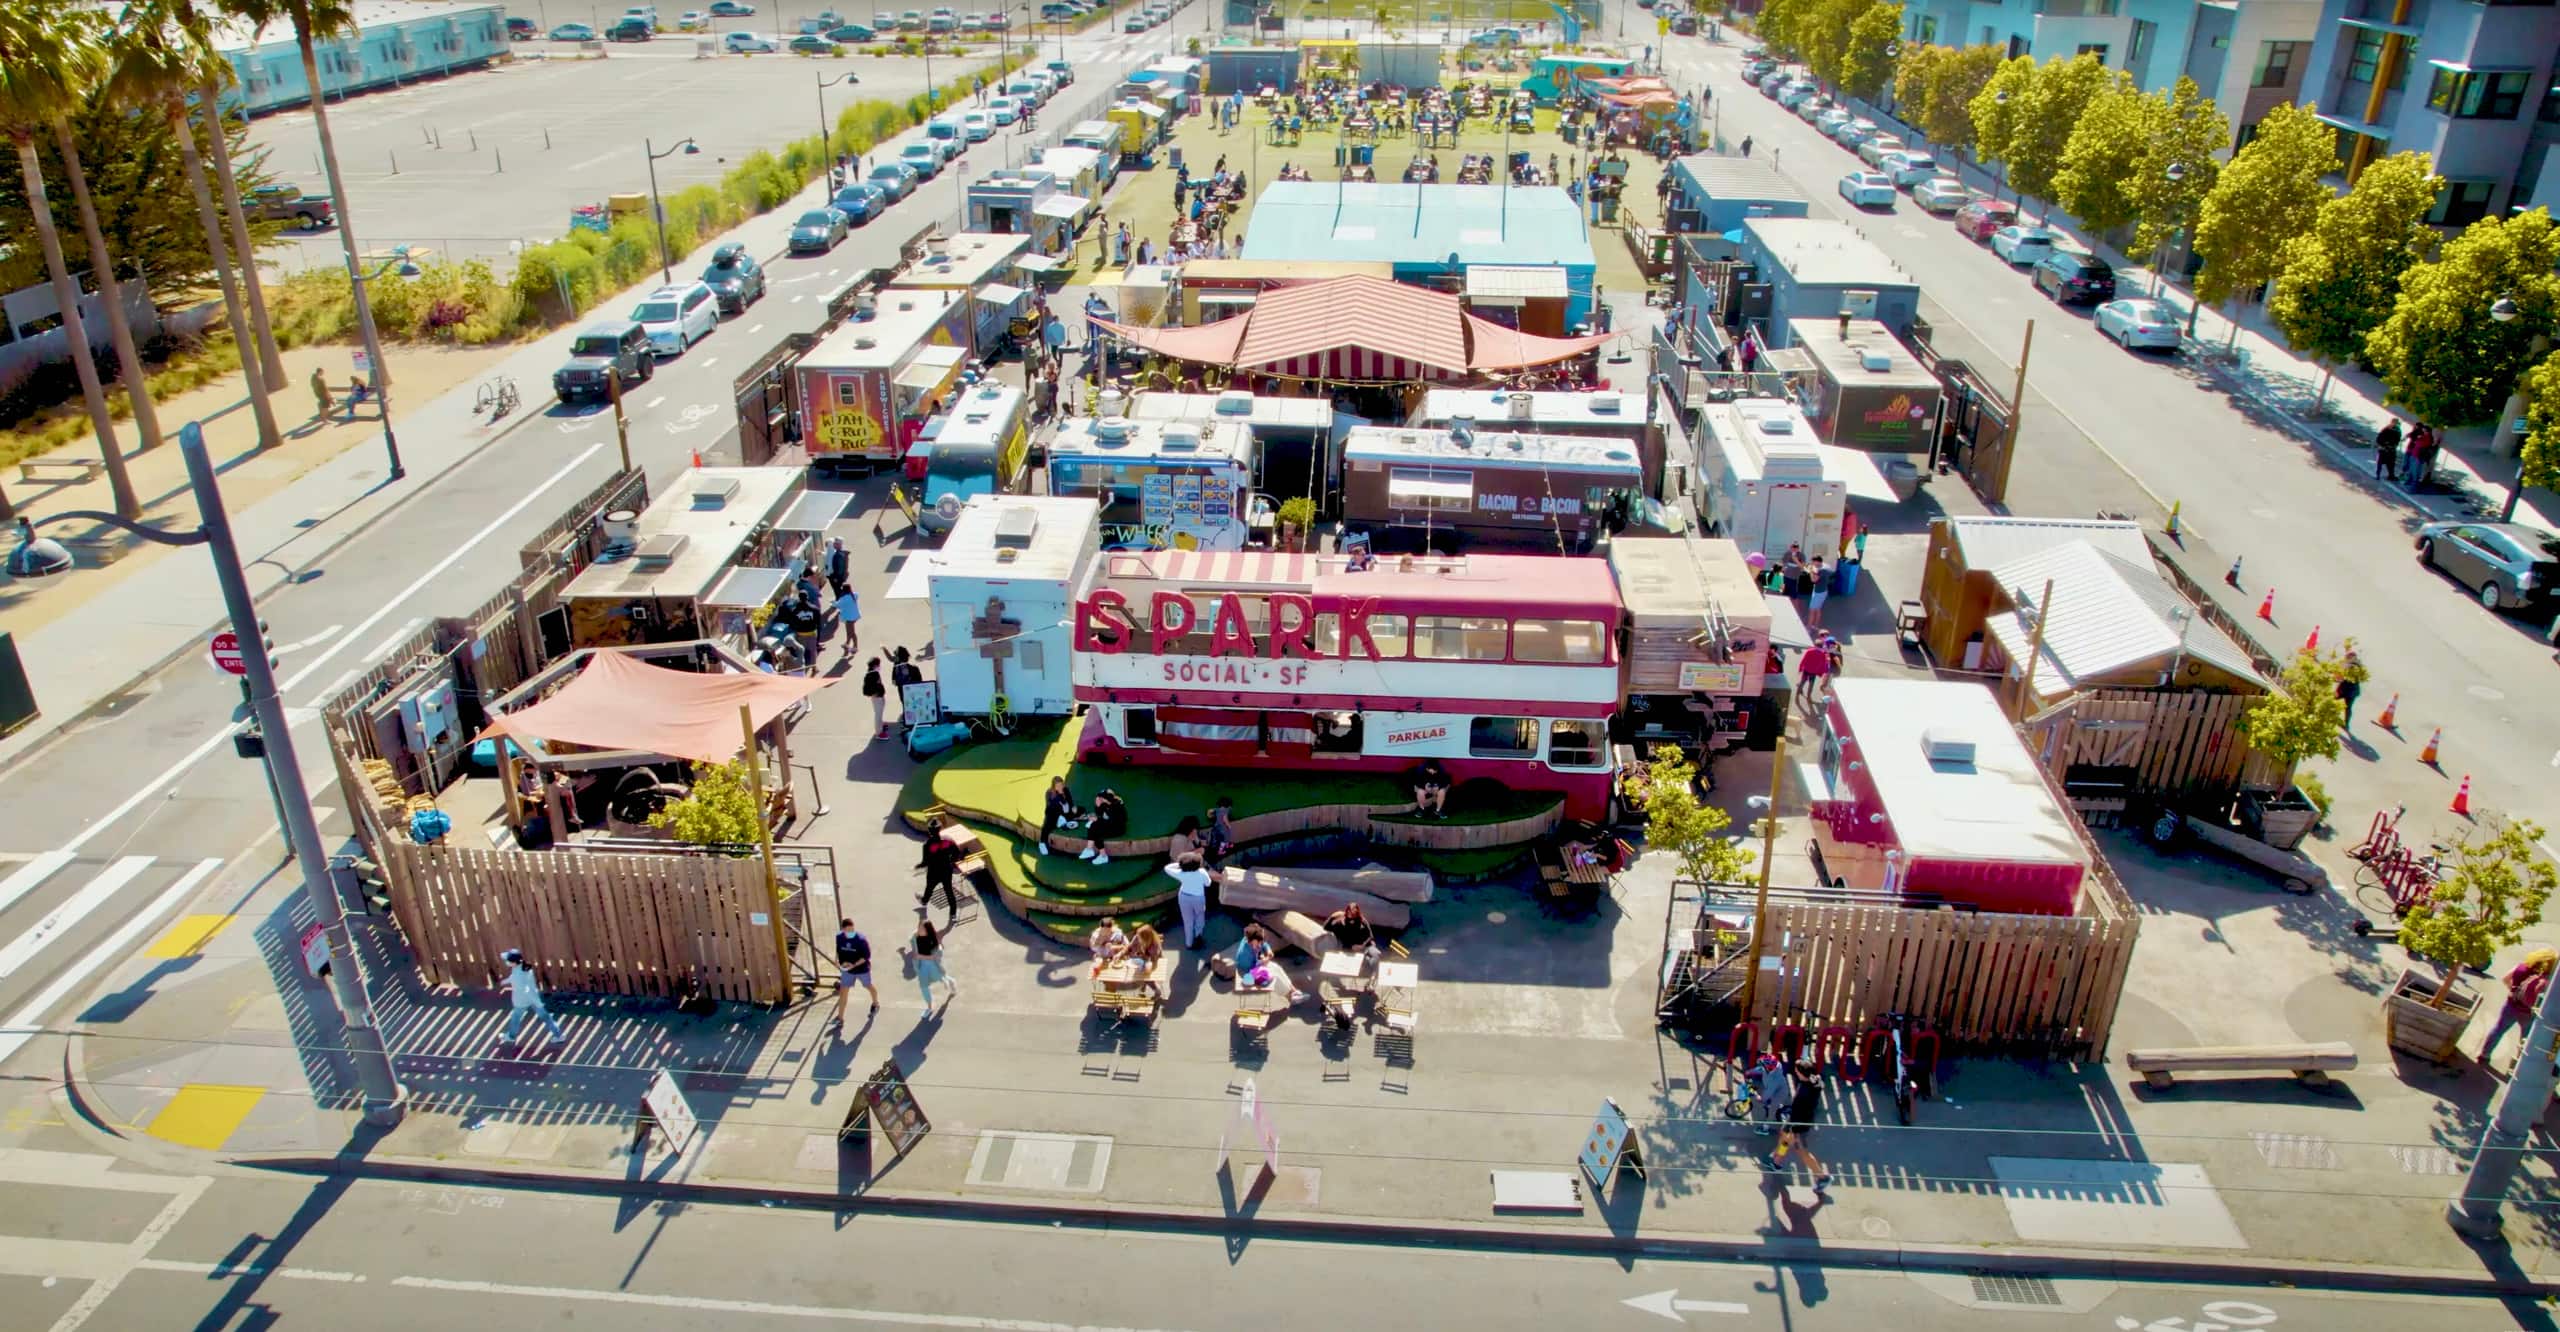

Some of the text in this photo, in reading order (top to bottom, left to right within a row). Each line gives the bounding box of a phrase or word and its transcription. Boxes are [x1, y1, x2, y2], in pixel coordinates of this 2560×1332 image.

[1478, 494, 1580, 514] BACON BACON
[1088, 588, 1382, 663] SPARK
[215, 641, 227, 649] DO
[224, 660, 246, 668] ENTE
[1163, 662, 1308, 686] SOCIAL SF
[1388, 728, 1447, 744] PARKLAB
